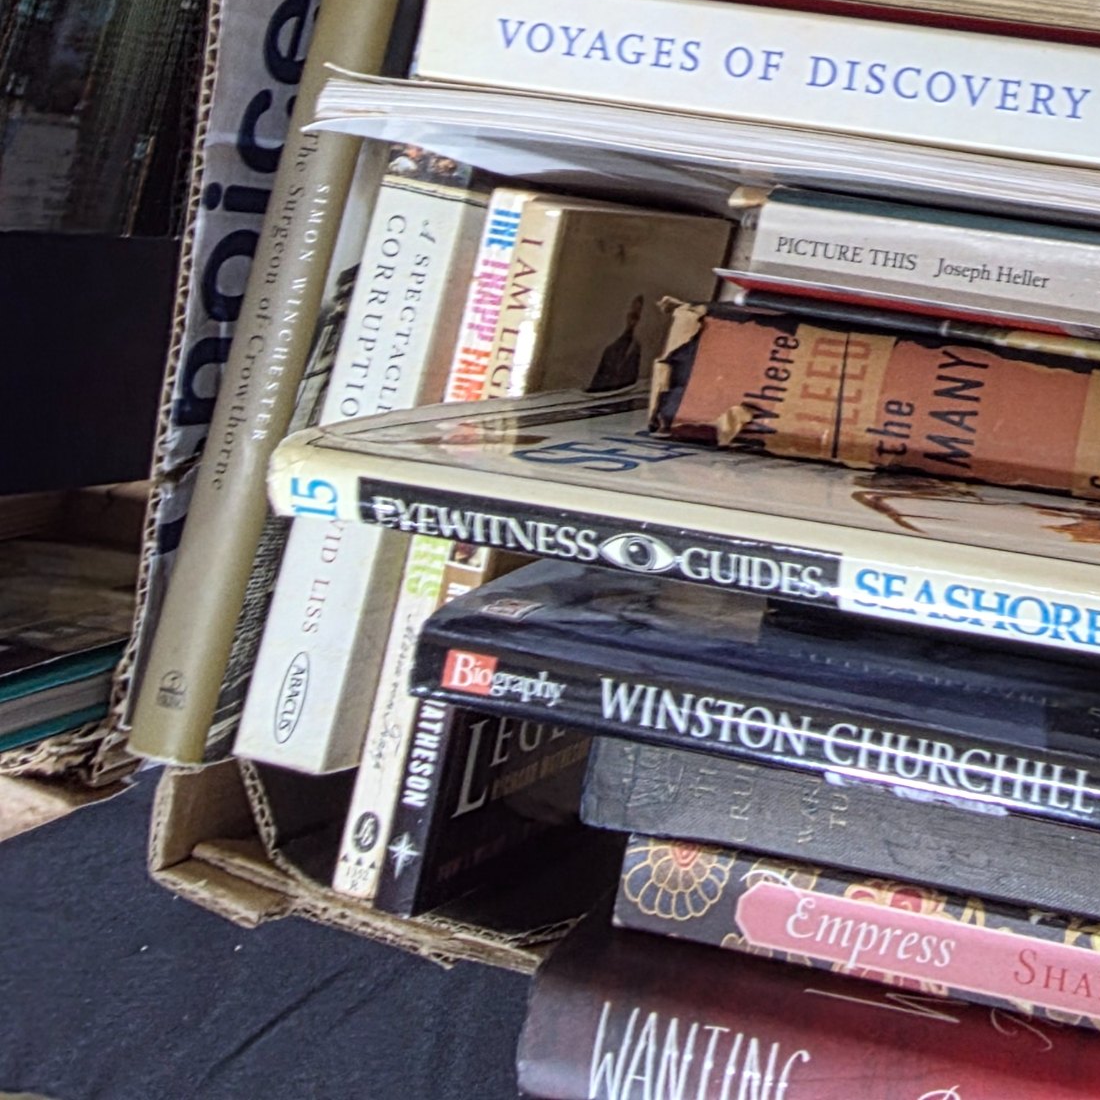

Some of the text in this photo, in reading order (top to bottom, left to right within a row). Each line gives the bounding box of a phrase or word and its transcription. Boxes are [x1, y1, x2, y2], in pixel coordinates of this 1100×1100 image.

[498, 17, 1092, 120] VOYAGES OF DISCOVERY
[265, 185, 304, 284] Surgeon
[775, 236, 1050, 289] PICTURE THIS Joseph Heller
[251, 183, 330, 441] SIMON WINCHESTER
[340, 214, 407, 418] CORRUPTIO
[212, 334, 265, 491] Crowthorne
[866, 399, 915, 458] the
[924, 350, 989, 469] MANY
[290, 476, 339, 521] 15
[373, 495, 824, 600] EYEWITNESS GUIDES
[303, 576, 331, 635] LISS
[278, 663, 307, 736] ABACUS
[450, 653, 566, 707] Biography
[402, 700, 448, 807] ATHESON
[600, 678, 812, 756] WINSTON
[824, 722, 1095, 814] CHURCHILL
[785, 888, 957, 971] Empress
